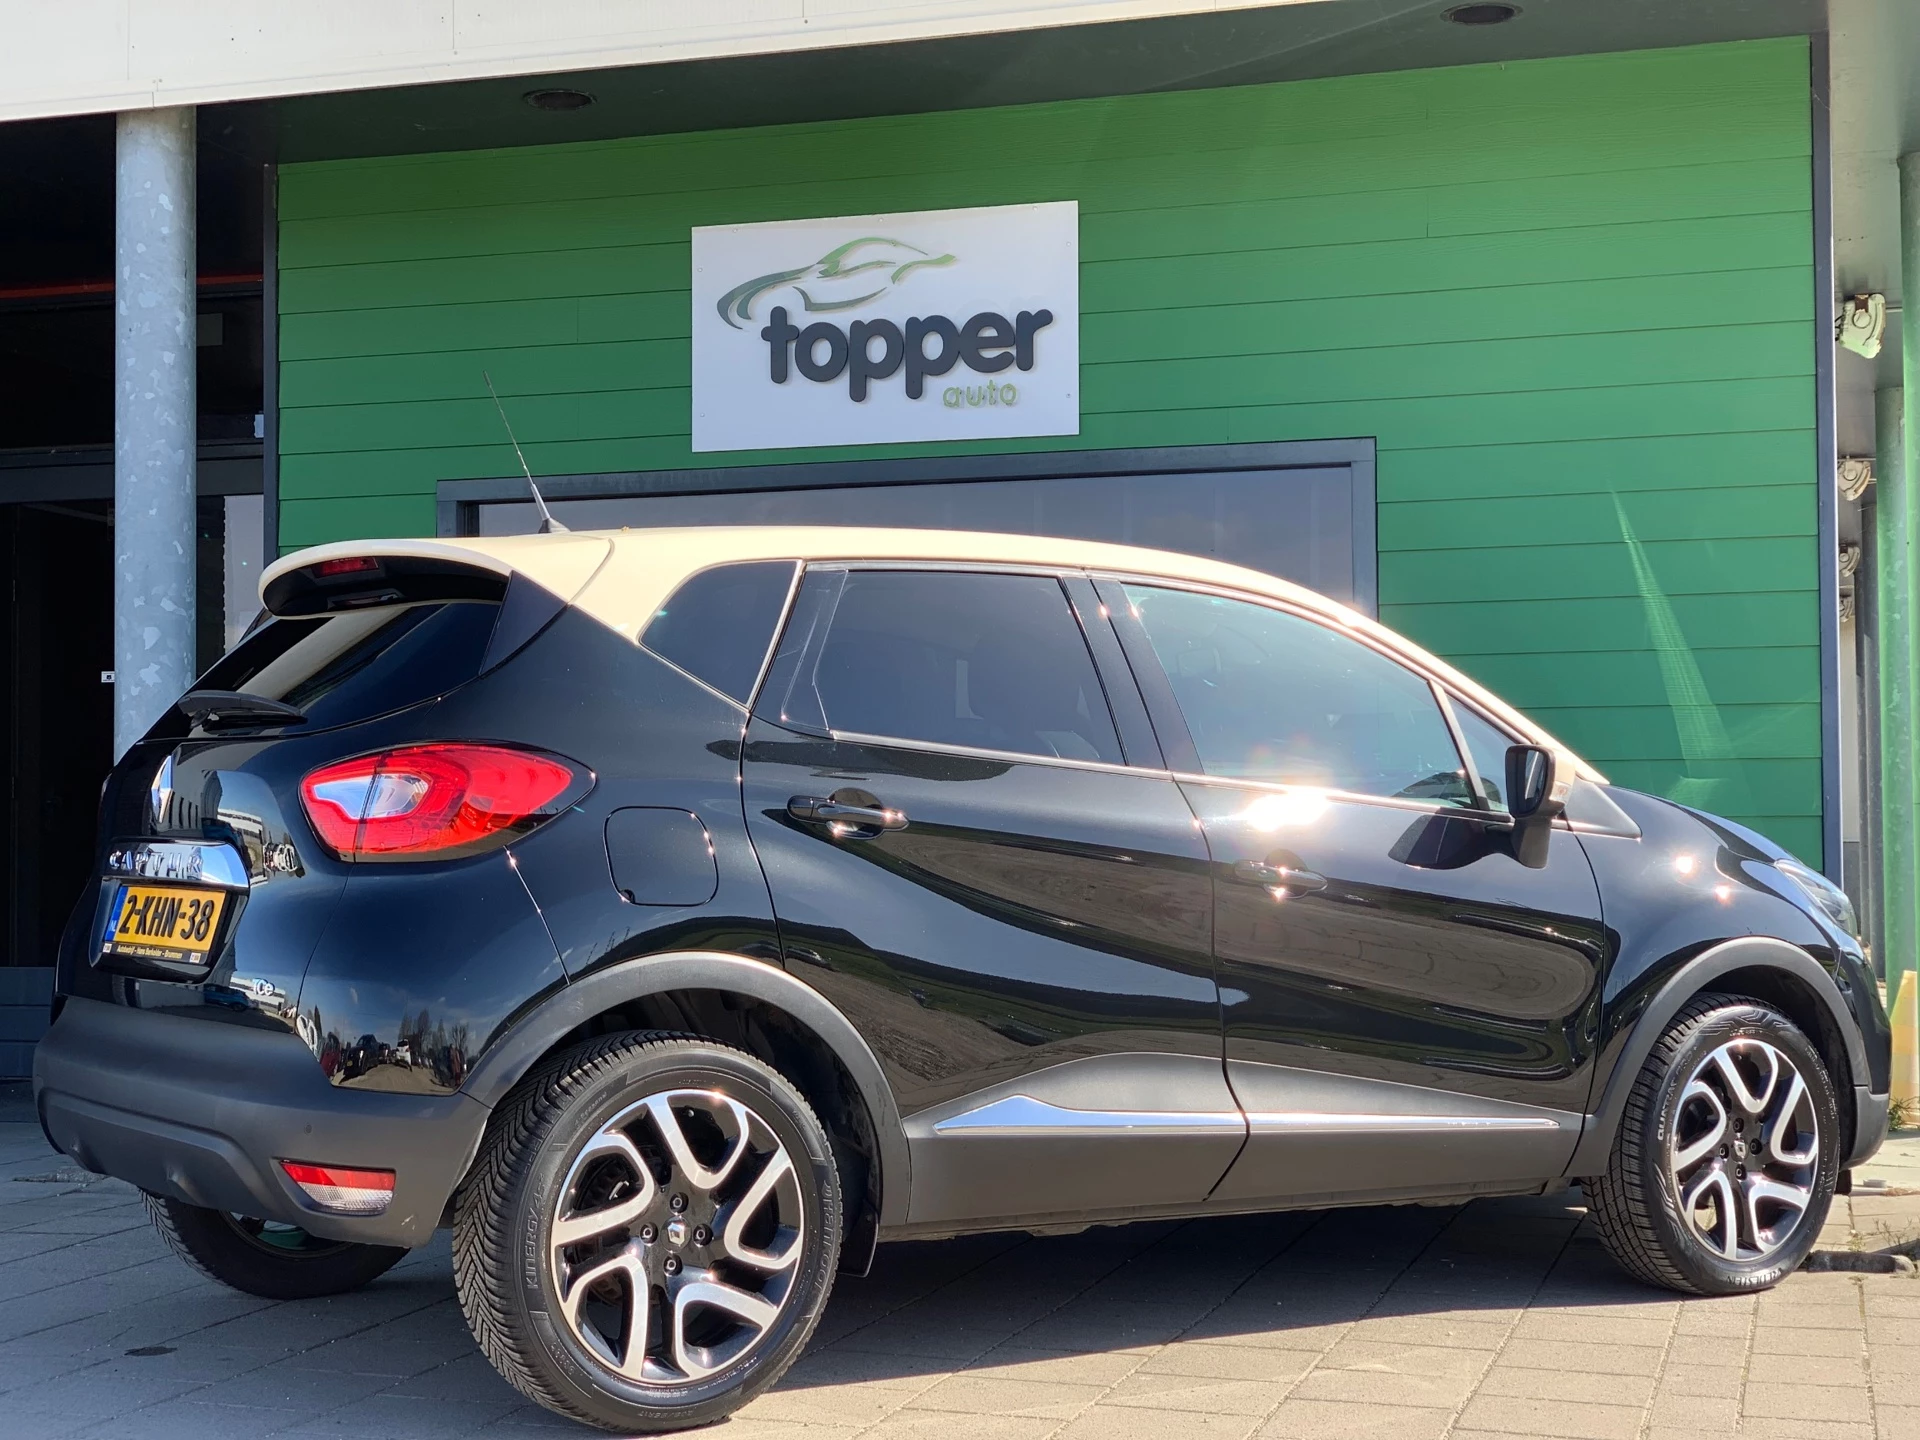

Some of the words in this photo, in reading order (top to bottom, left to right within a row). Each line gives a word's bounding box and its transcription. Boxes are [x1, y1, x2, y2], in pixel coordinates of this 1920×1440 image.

[761, 306, 1053, 402] topper
[942, 379, 1018, 409] auto
[118, 895, 215, 941] 2-KHN-38
